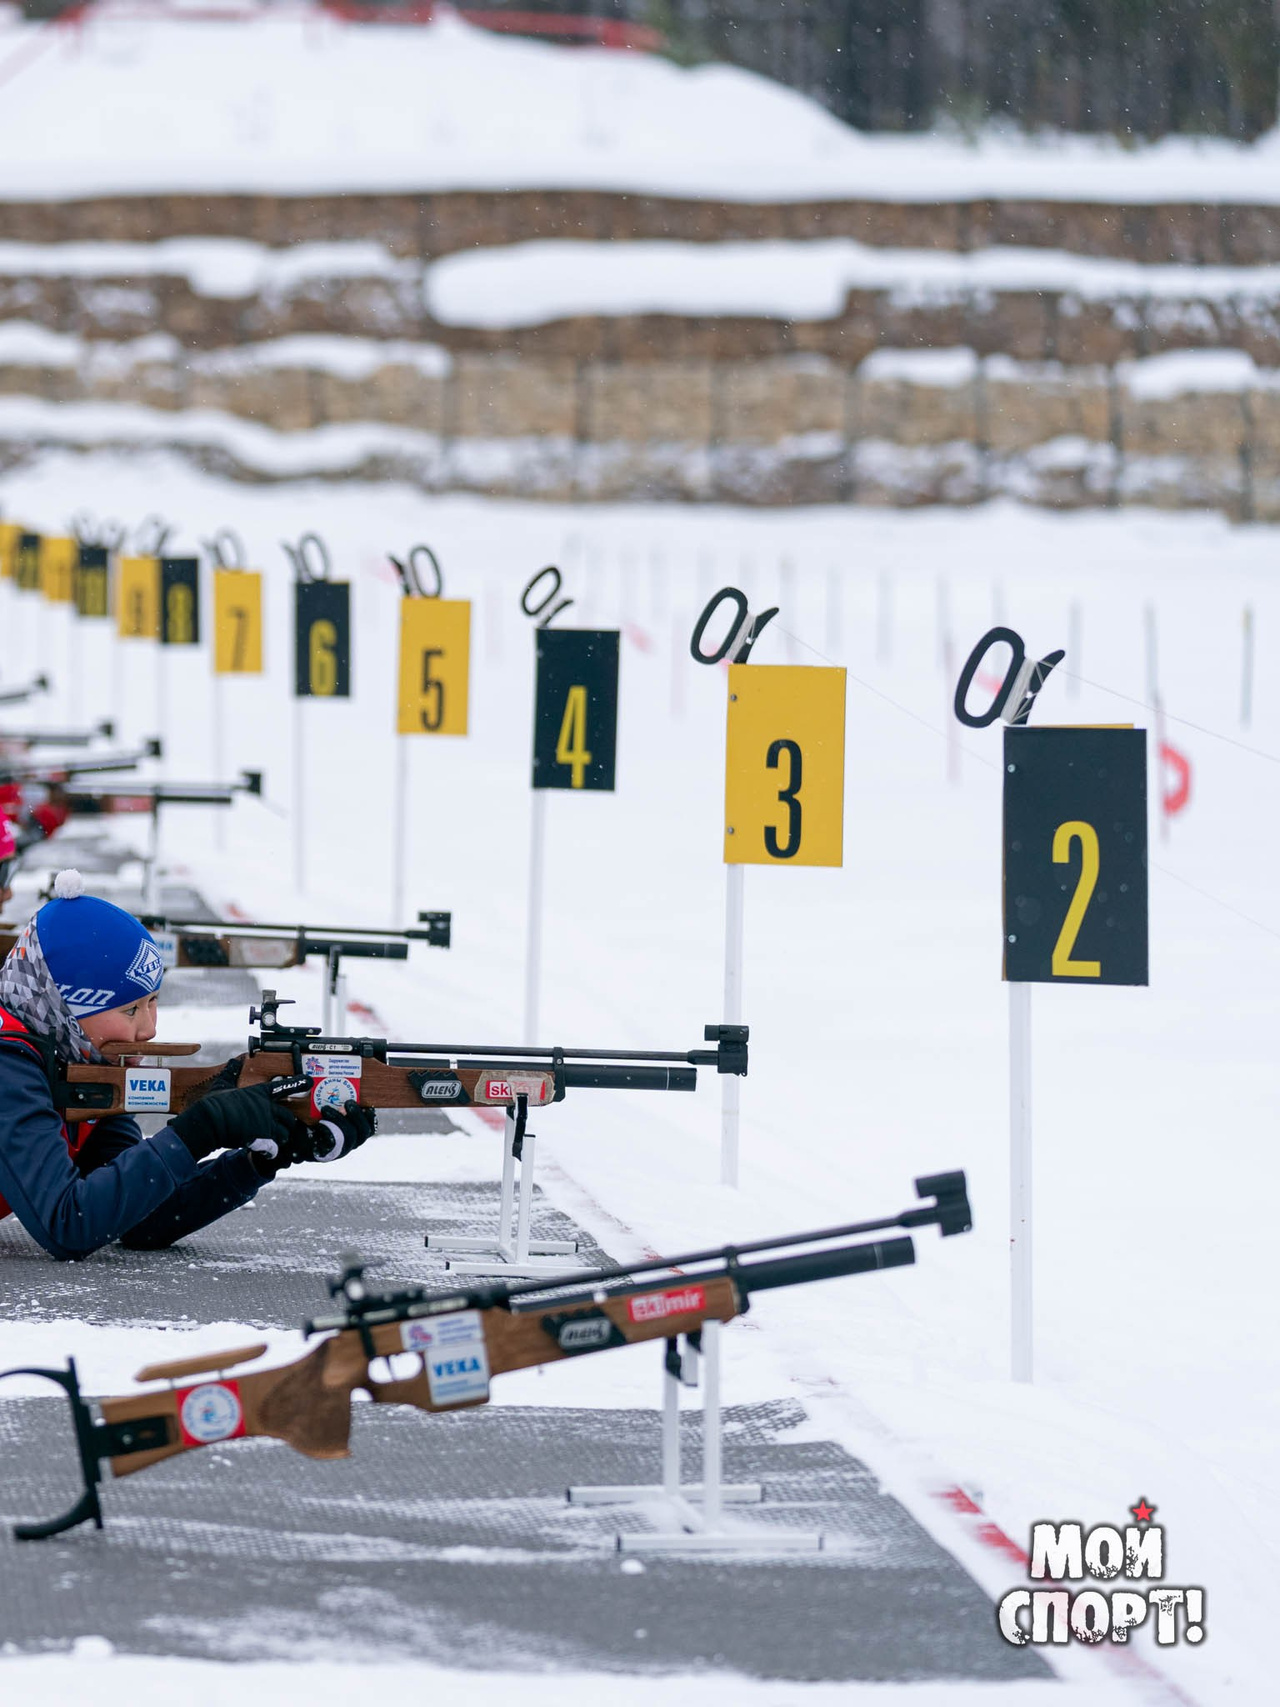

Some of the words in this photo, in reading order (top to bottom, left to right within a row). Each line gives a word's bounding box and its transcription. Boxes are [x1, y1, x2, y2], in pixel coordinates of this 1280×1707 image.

[228, 606, 250, 670] 7
[309, 618, 338, 696] 6
[422, 648, 446, 731] 5
[556, 685, 592, 788] 4
[764, 739, 803, 858] 3
[1052, 820, 1101, 977] 2
[129, 1079, 167, 1092] VEKA
[433, 1355, 480, 1379] VEKA
